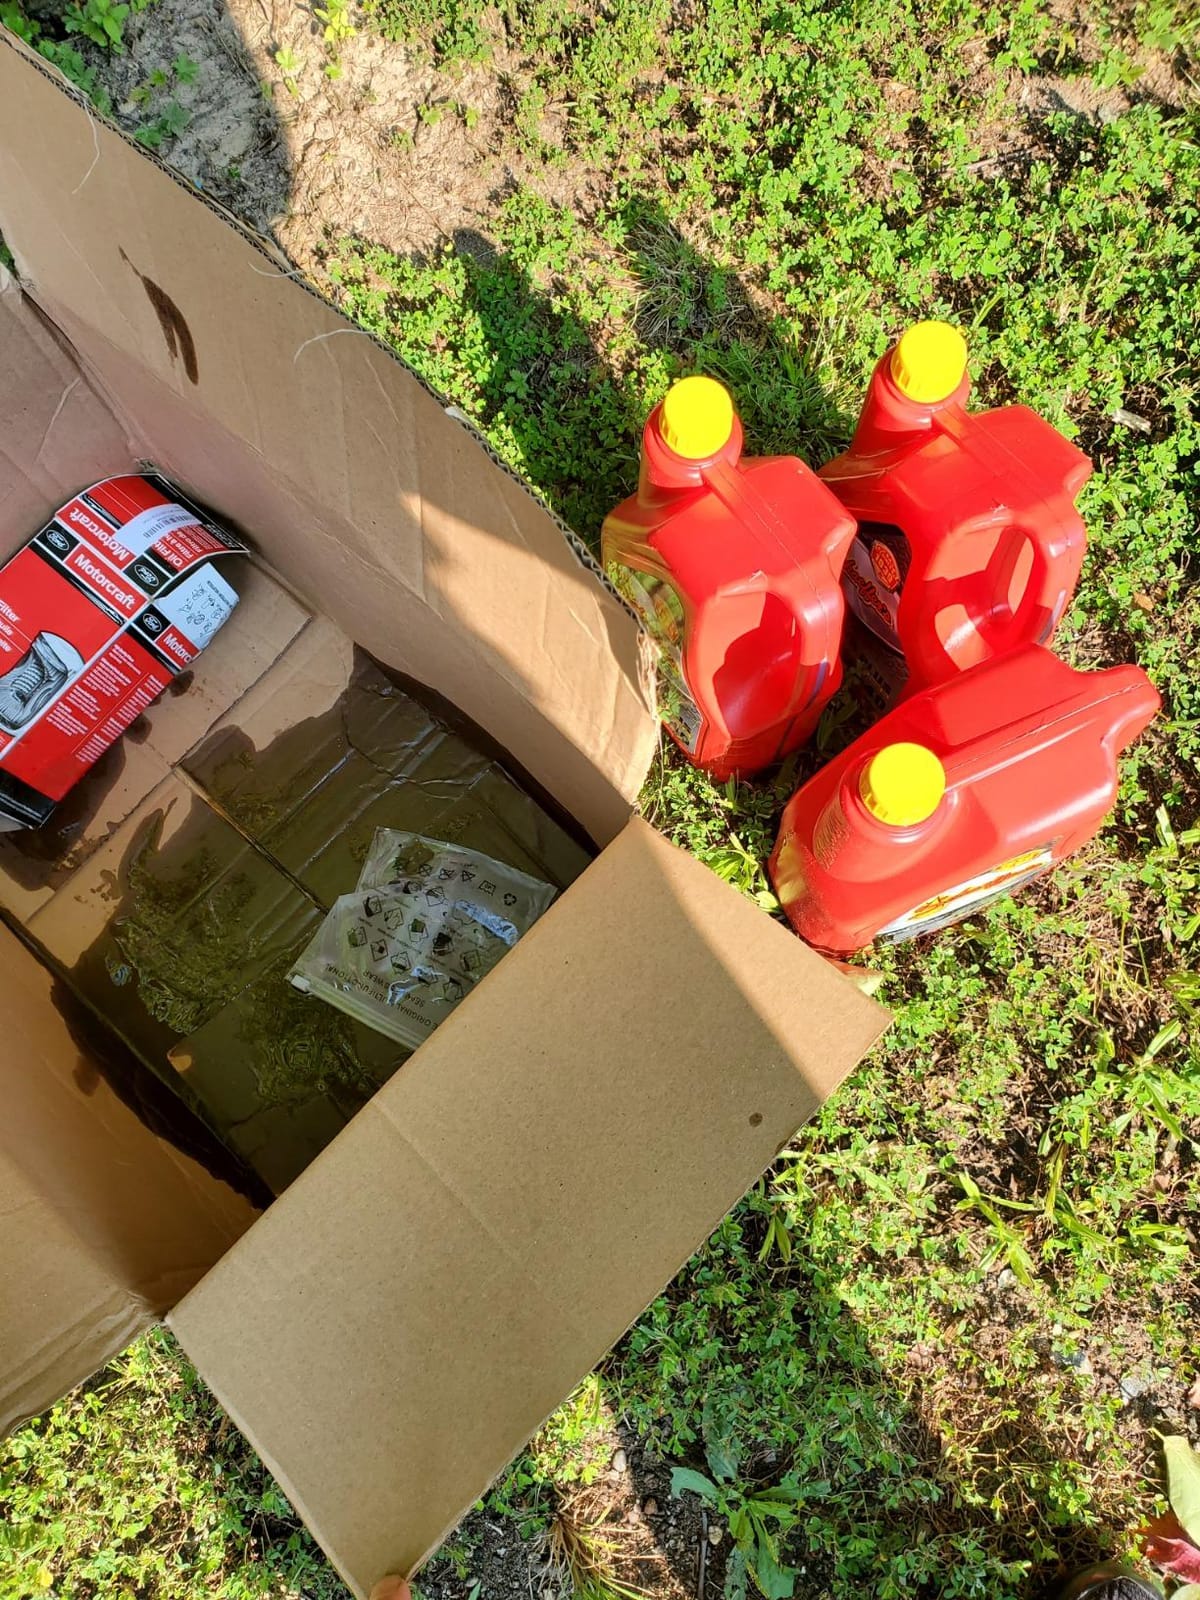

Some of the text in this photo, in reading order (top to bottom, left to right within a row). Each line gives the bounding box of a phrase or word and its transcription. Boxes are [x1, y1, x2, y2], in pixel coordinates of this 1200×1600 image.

[48, 531, 67, 549] Ford
[69, 507, 130, 561] Motorcraft
[168, 552, 184, 567] Oil
[74, 553, 136, 610] Motorcraft
[137, 566, 157, 585] Ford
[143, 614, 161, 632] Ford
[326, 963, 432, 1027] ORIGINAL ULTIFUNCTIONAL
